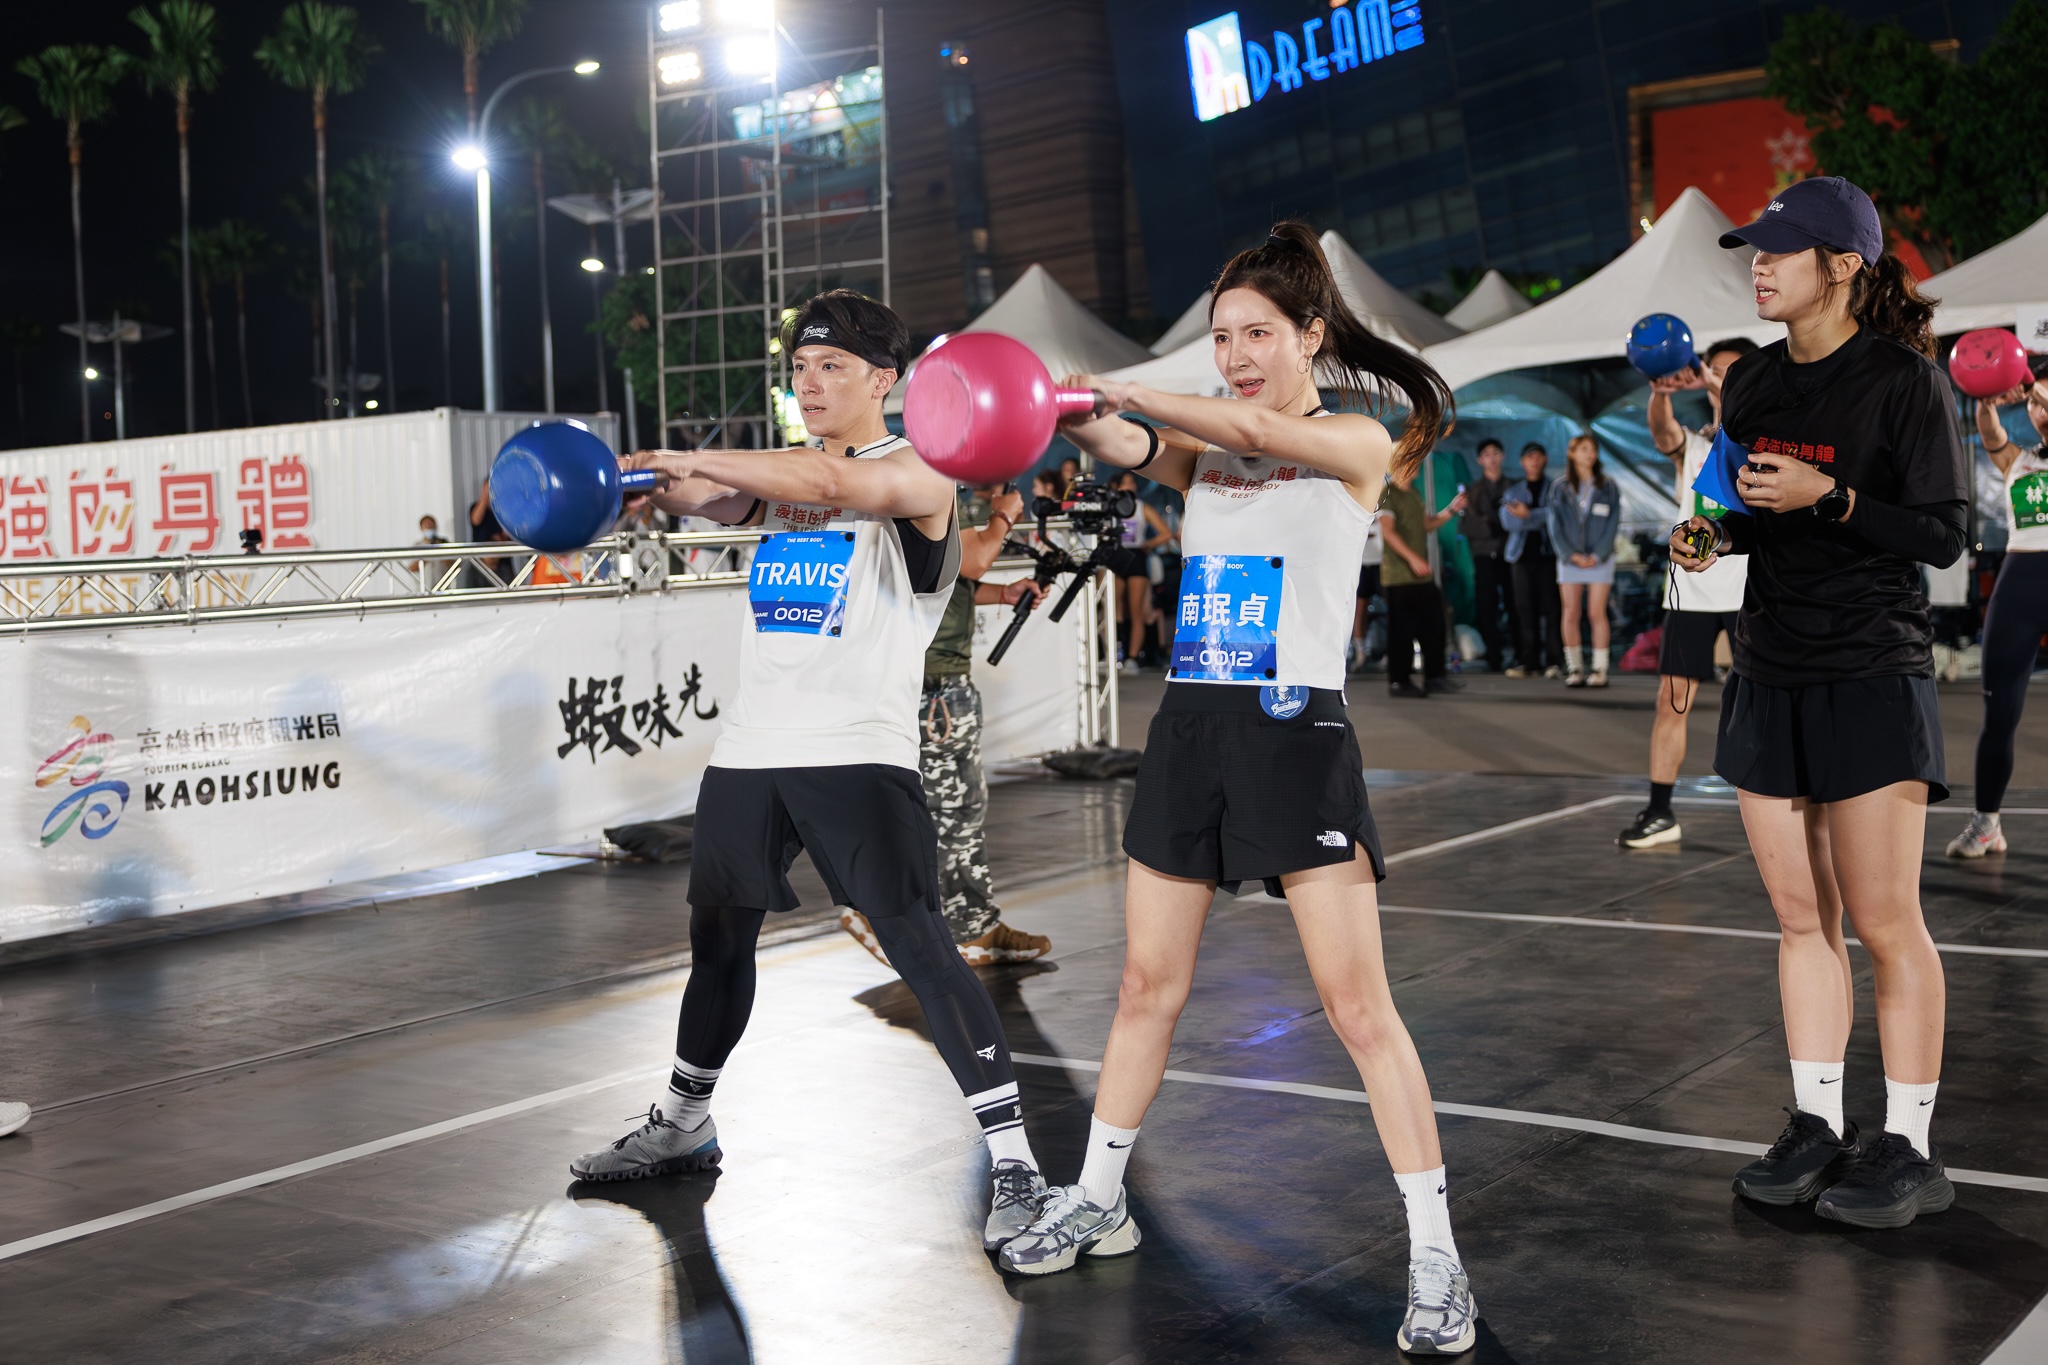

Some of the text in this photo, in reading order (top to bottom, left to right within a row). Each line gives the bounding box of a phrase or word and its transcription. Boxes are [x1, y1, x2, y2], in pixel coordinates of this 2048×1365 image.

[1246, 0, 1395, 102] DREAM
[801, 325, 829, 341] Travis
[1209, 486, 1229, 497] THE
[1230, 491, 1255, 499] BEST
[2025, 485, 2048, 505] 林
[1073, 501, 1102, 511] RONIN
[755, 562, 846, 589] TRAVIS
[774, 607, 823, 623] 0012
[1181, 592, 1269, 628] 南珉貞
[1199, 649, 1254, 667] 0012
[137, 713, 341, 758] 高雄市政府觀光局
[144, 763, 189, 776] TOURISM
[145, 761, 341, 812] KAOHSIUNG
